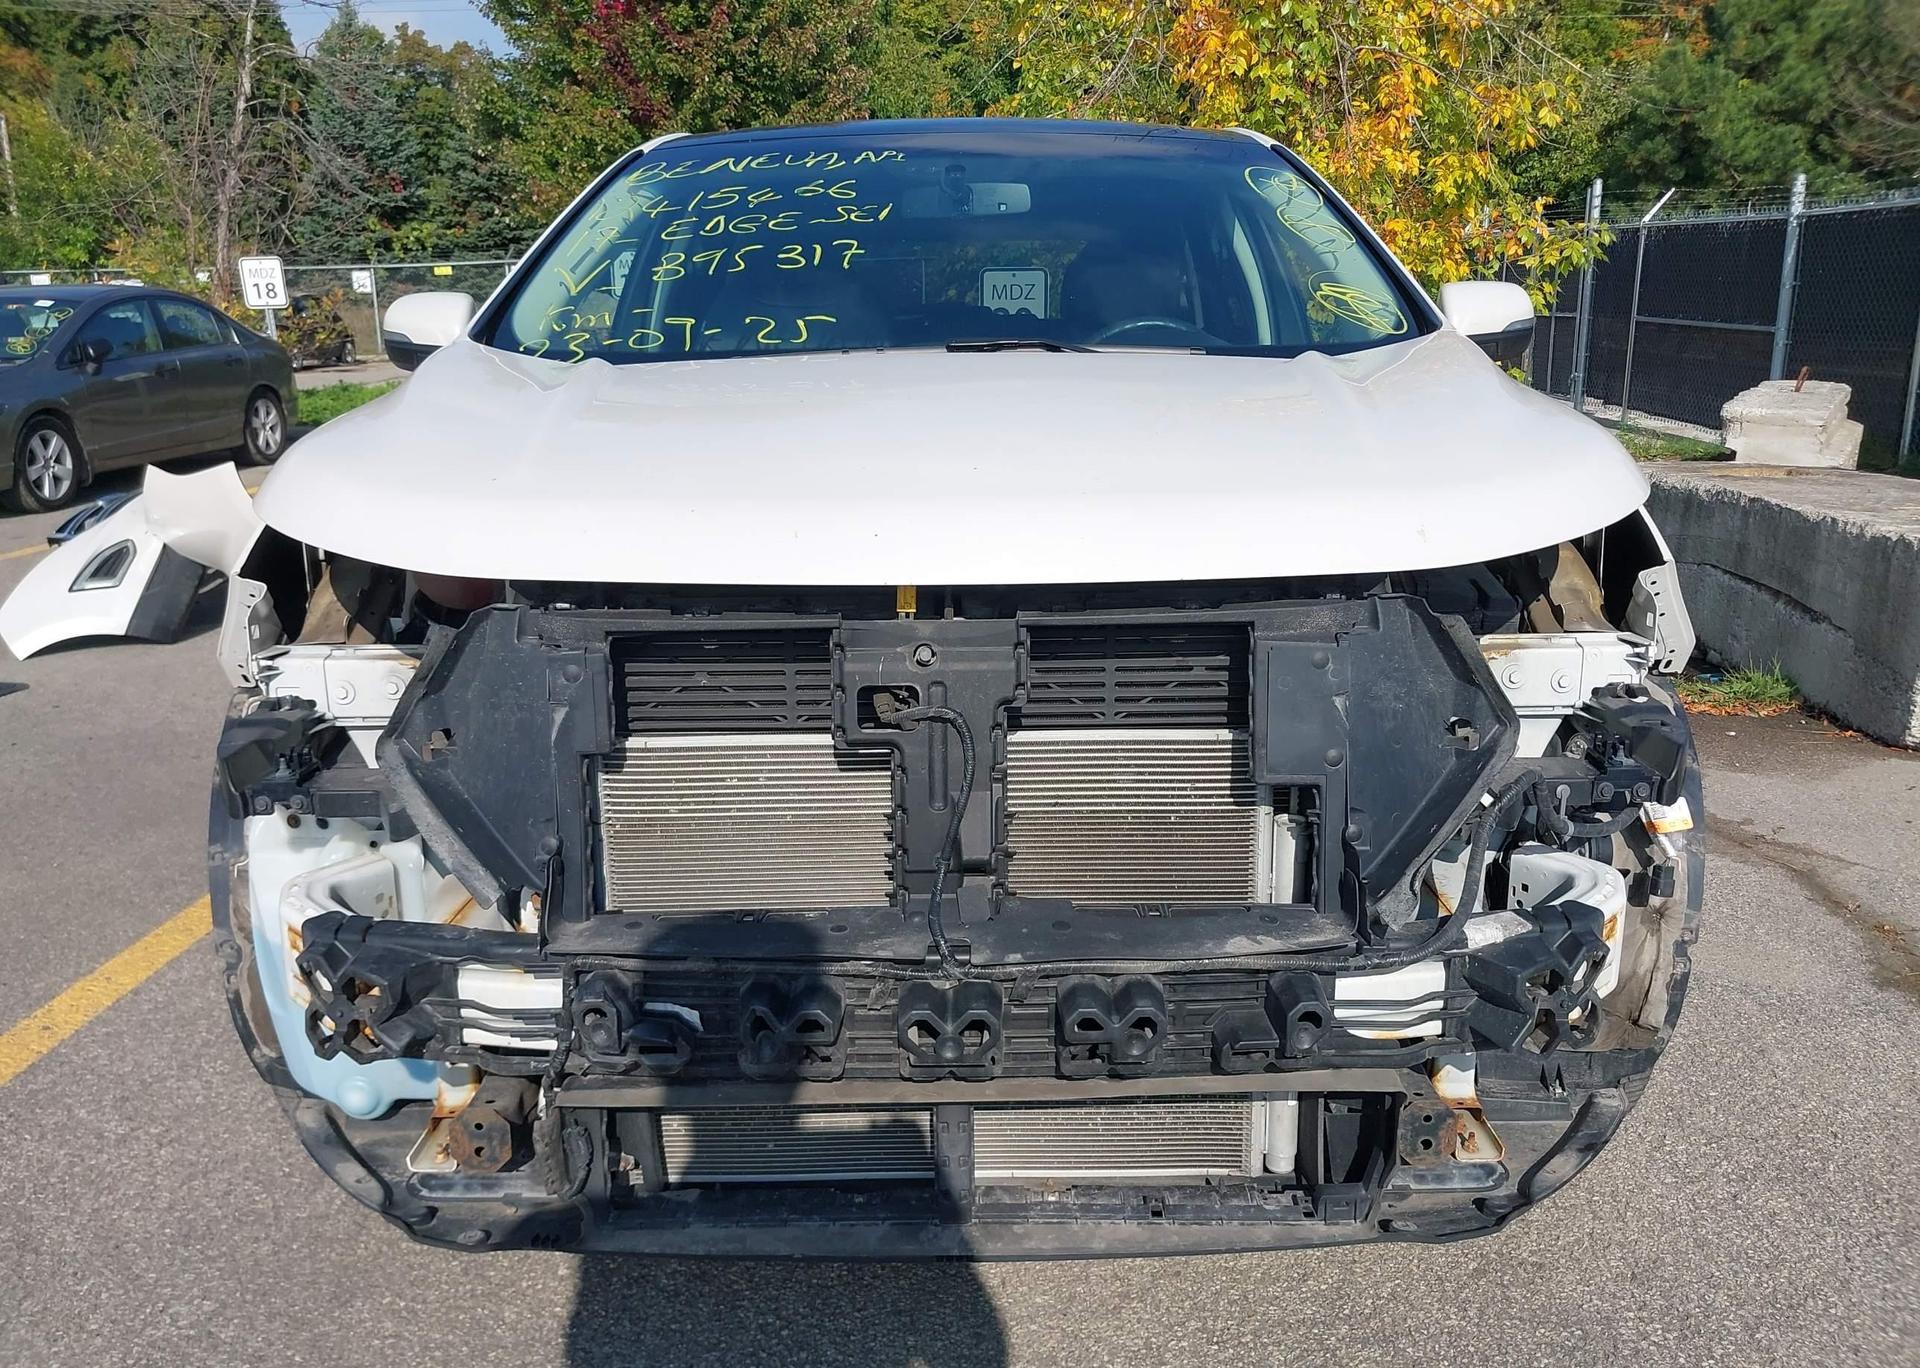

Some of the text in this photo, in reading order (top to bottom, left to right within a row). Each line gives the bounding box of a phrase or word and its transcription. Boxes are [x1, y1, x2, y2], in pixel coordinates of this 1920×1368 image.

[660, 210, 803, 241] EDGE
[248, 267, 277, 280] MDZ
[252, 282, 278, 300] 18
[991, 283, 1037, 301] MDZ
